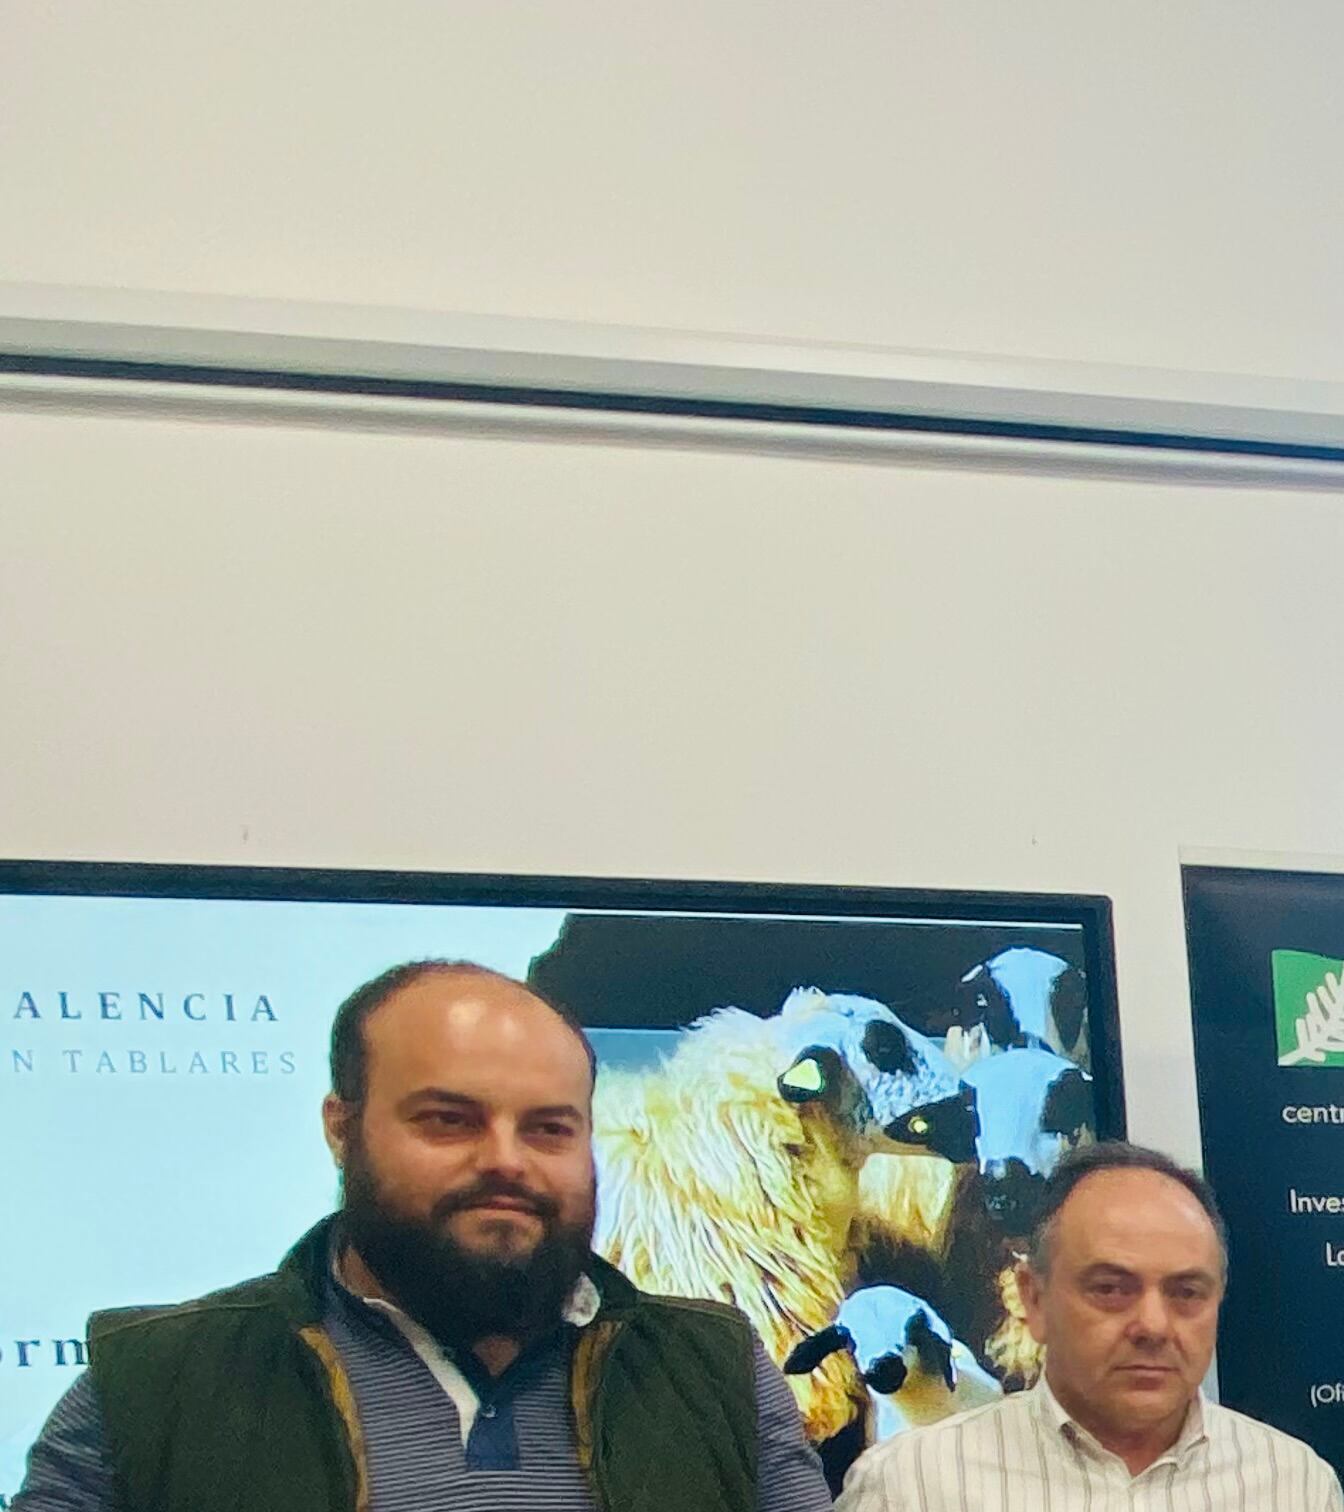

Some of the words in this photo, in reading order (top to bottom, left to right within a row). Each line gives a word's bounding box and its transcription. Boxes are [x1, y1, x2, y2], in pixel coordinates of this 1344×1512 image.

[13, 990, 279, 1021] ALENCIA
[12, 1049, 33, 1072] N
[62, 1049, 296, 1075] TABLARES
